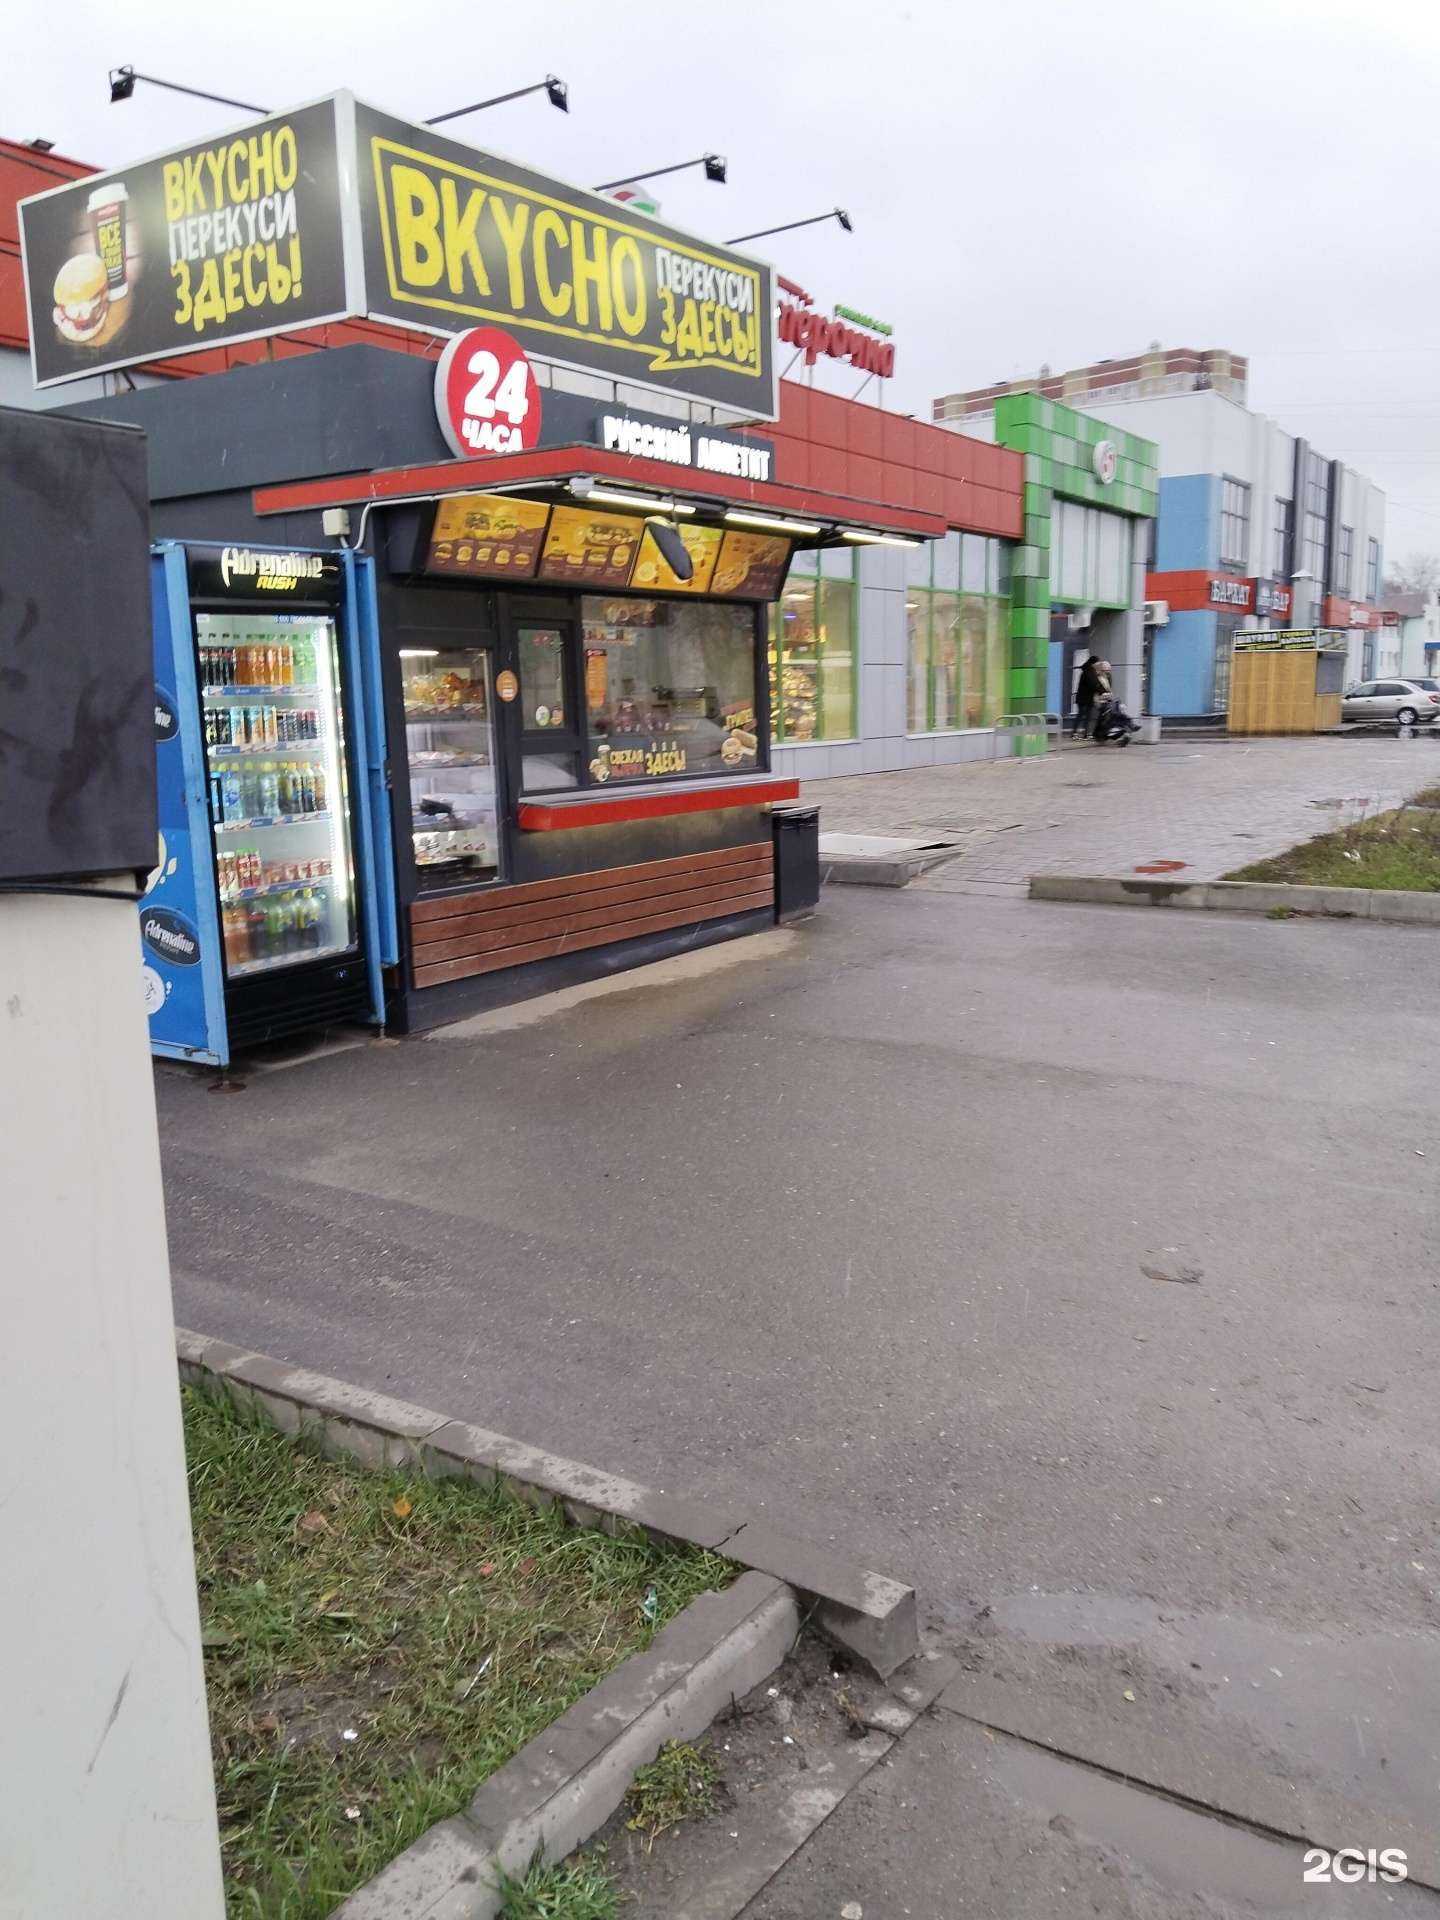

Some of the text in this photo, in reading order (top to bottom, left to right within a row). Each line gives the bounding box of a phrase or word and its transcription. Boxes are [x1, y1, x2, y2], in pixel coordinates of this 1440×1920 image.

[162, 124, 298, 222] ВКУСНО
[168, 188, 297, 264] ПЕРЕКУСИ
[390, 164, 647, 337] ВКУСНО
[170, 233, 302, 332] ЗДЕСЬ!
[655, 247, 754, 314] ПЕРЕКУСИ
[657, 287, 756, 363] ЗДЕСЬ!
[464, 350, 529, 425] 24
[461, 417, 524, 453] ЧАСА
[603, 415, 692, 466] РУССКИЙ
